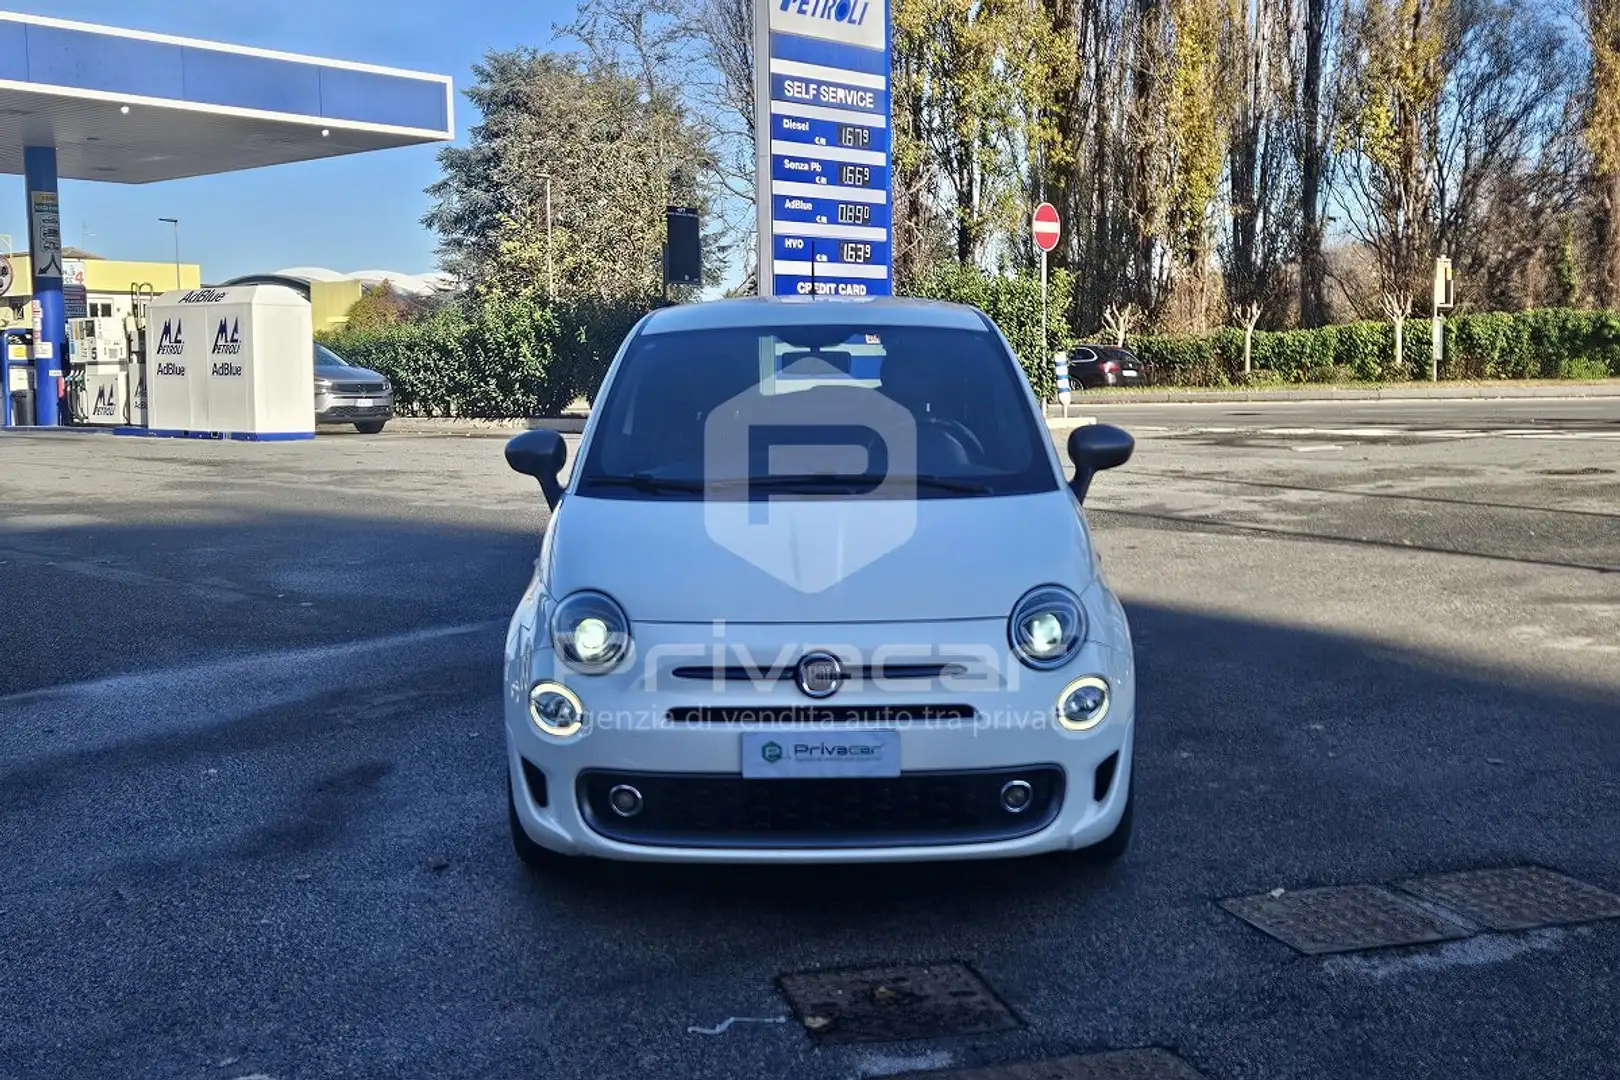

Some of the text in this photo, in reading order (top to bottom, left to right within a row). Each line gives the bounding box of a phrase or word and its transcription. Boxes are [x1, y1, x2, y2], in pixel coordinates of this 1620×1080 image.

[784, 80, 874, 108] SELF SERVICE
[783, 119, 809, 131] Diesel
[784, 159, 822, 172] Senza Pb
[784, 199, 813, 211] AdBlue
[784, 238, 804, 249] HVO
[178, 288, 226, 304] AdBlue
[797, 282, 867, 296] CREDIT CARD
[157, 362, 185, 376] AdBlue
[212, 362, 242, 376] AdBlue
[794, 741, 885, 756] Privacar
